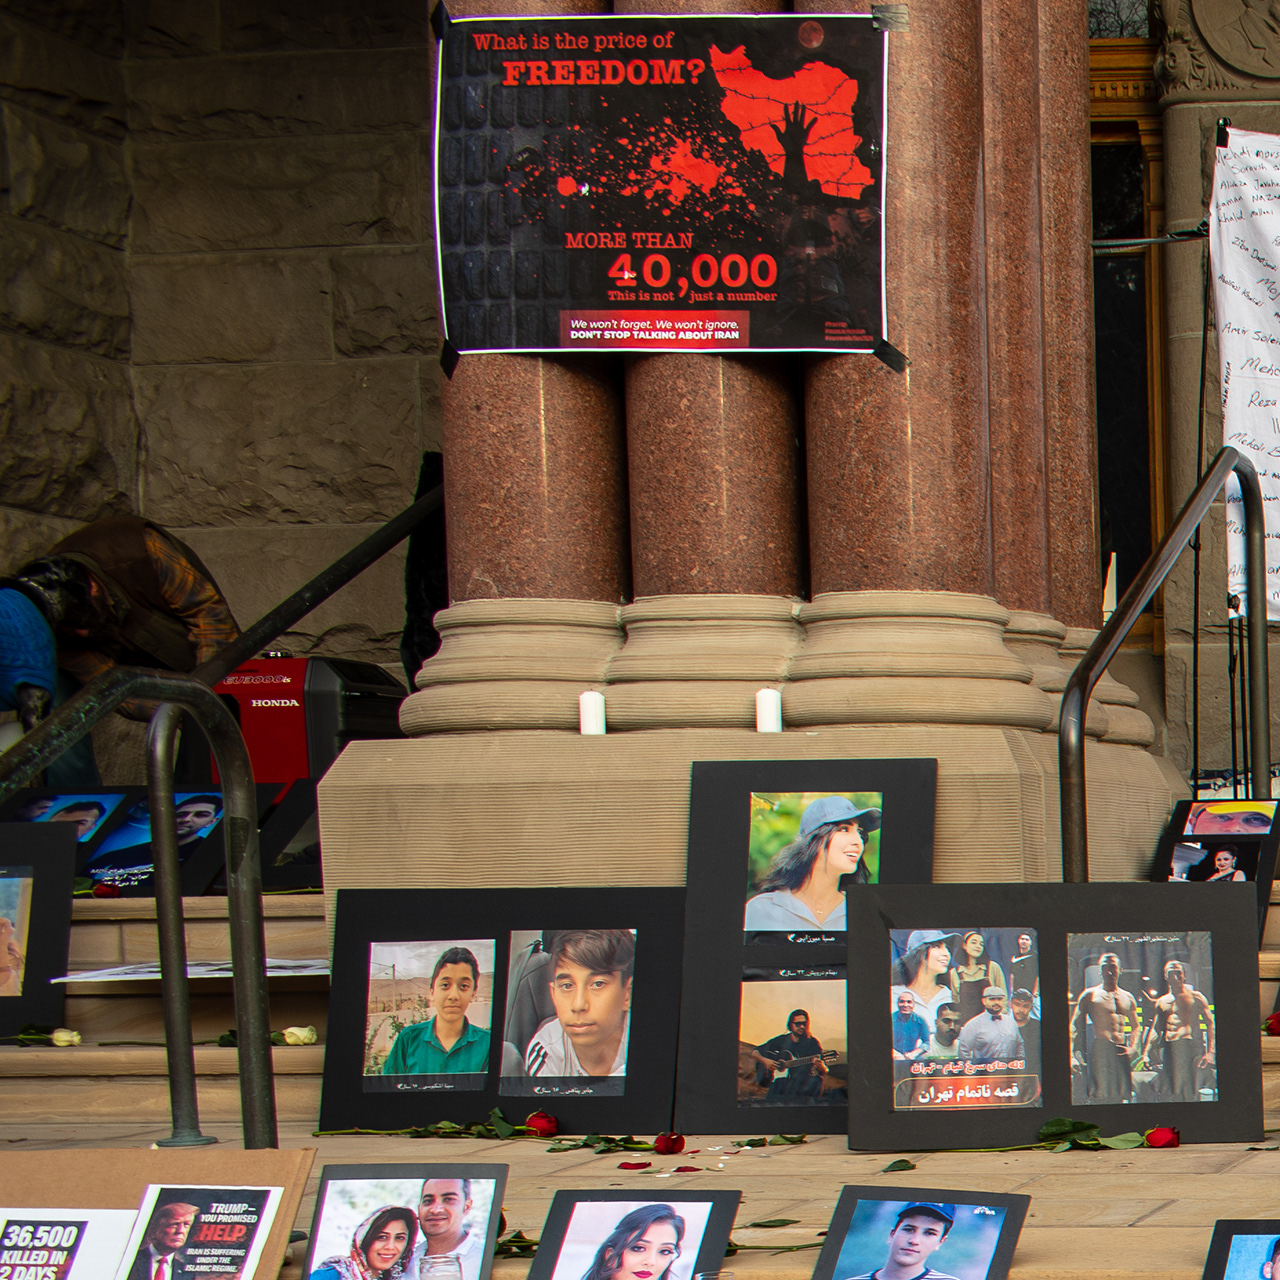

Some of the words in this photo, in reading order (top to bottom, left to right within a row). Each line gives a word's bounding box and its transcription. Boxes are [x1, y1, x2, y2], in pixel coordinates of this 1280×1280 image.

[472, 34, 527, 50] What
[532, 33, 550, 49] is
[555, 33, 589, 49] the
[594, 32, 647, 52] price
[653, 31, 675, 48] of
[502, 58, 706, 86] FREEDOM?
[565, 232, 627, 249] MORE
[632, 232, 695, 249] THAN
[607, 253, 778, 298] 40,000
[608, 290, 636, 301] This
[638, 290, 650, 301] is
[652, 291, 675, 301] not
[688, 290, 714, 303] just
[716, 292, 725, 301] a
[726, 290, 777, 301] number
[571, 319, 587, 329] We
[589, 319, 618, 329] won't
[620, 320, 653, 330] forget.
[656, 320, 672, 329] We
[675, 320, 703, 329] won't
[705, 320, 739, 331] ignore.
[570, 330, 601, 339] DON'T
[603, 330, 631, 339] STOP
[633, 330, 676, 339] TALKING
[678, 331, 712, 339] ABOUT
[714, 331, 739, 339] IRAN
[251, 699, 300, 707] HONDA
[918, 1086, 953, 1104] تهران
[956, 1084, 991, 1102] ناتمام
[993, 1083, 1019, 1098] قصه
[200, 1214, 217, 1223] YOU
[217, 1214, 258, 1223] PROMISED
[3, 1225, 78, 1249] 36,500
[199, 1224, 247, 1242] HELP
[0, 1250, 49, 1265] KILLED
[49, 1250, 68, 1265] IN
